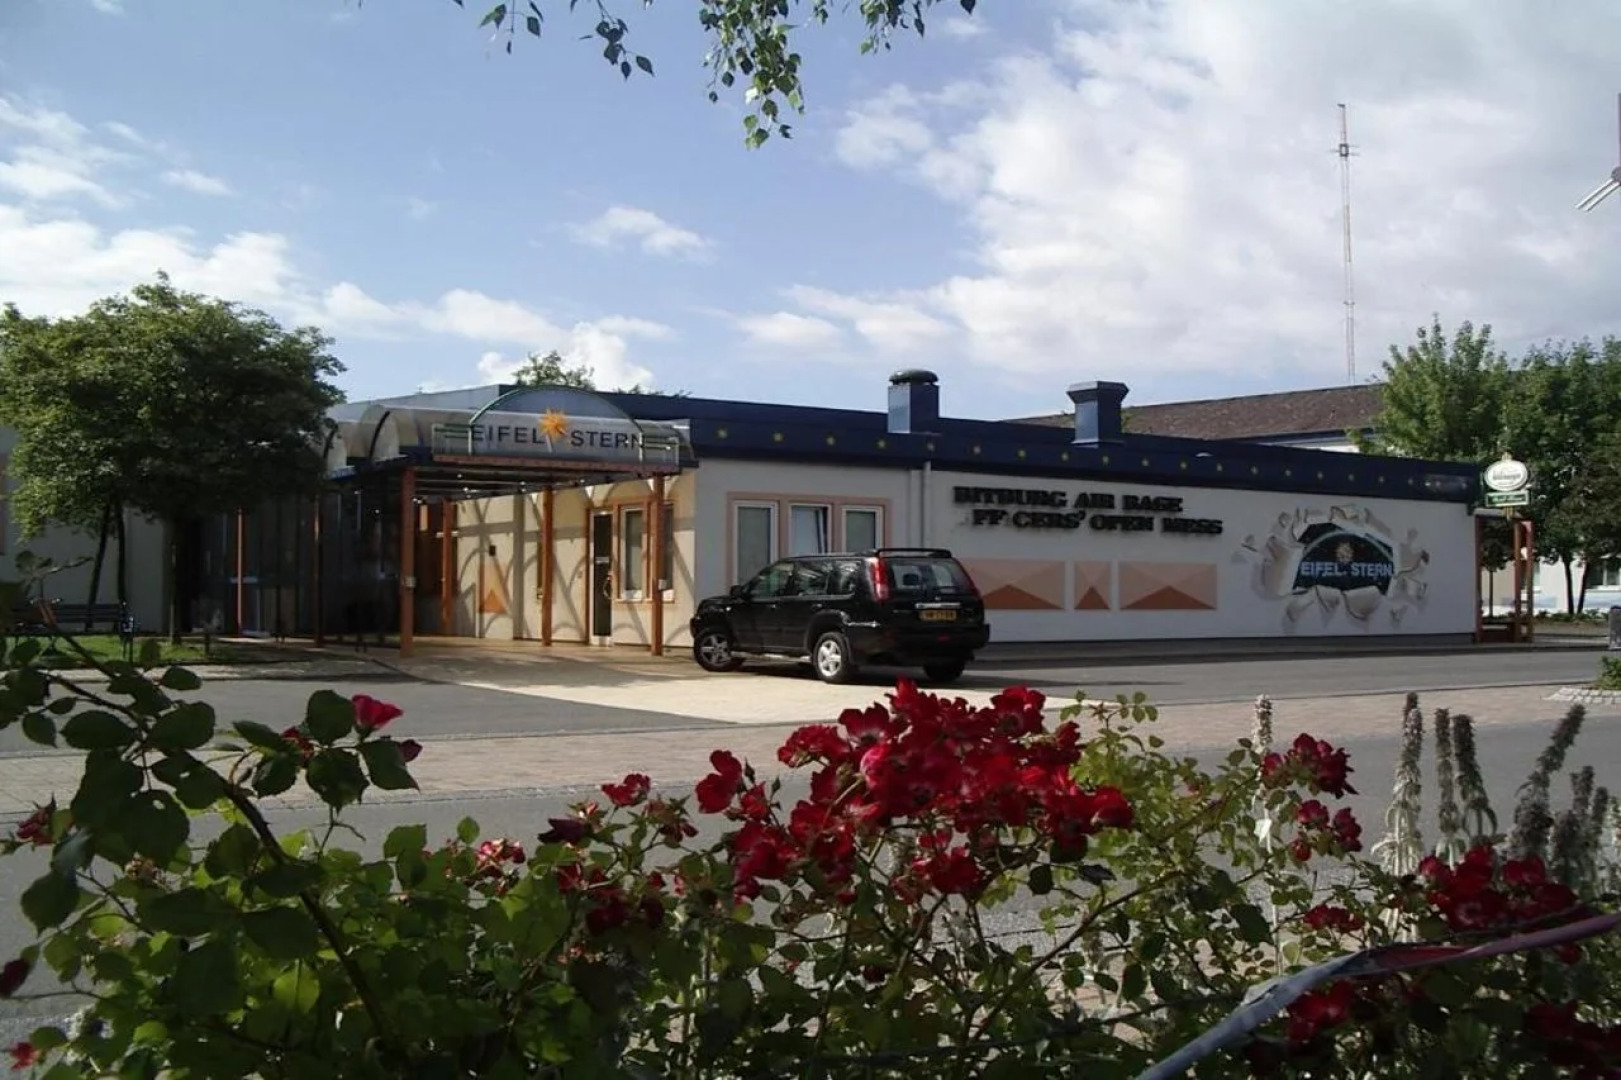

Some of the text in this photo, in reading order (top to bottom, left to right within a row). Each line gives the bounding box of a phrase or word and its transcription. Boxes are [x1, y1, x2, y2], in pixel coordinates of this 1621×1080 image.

[471, 424, 645, 449] EIFEL STERN
[1300, 561, 1394, 578] EIFEL STERN
